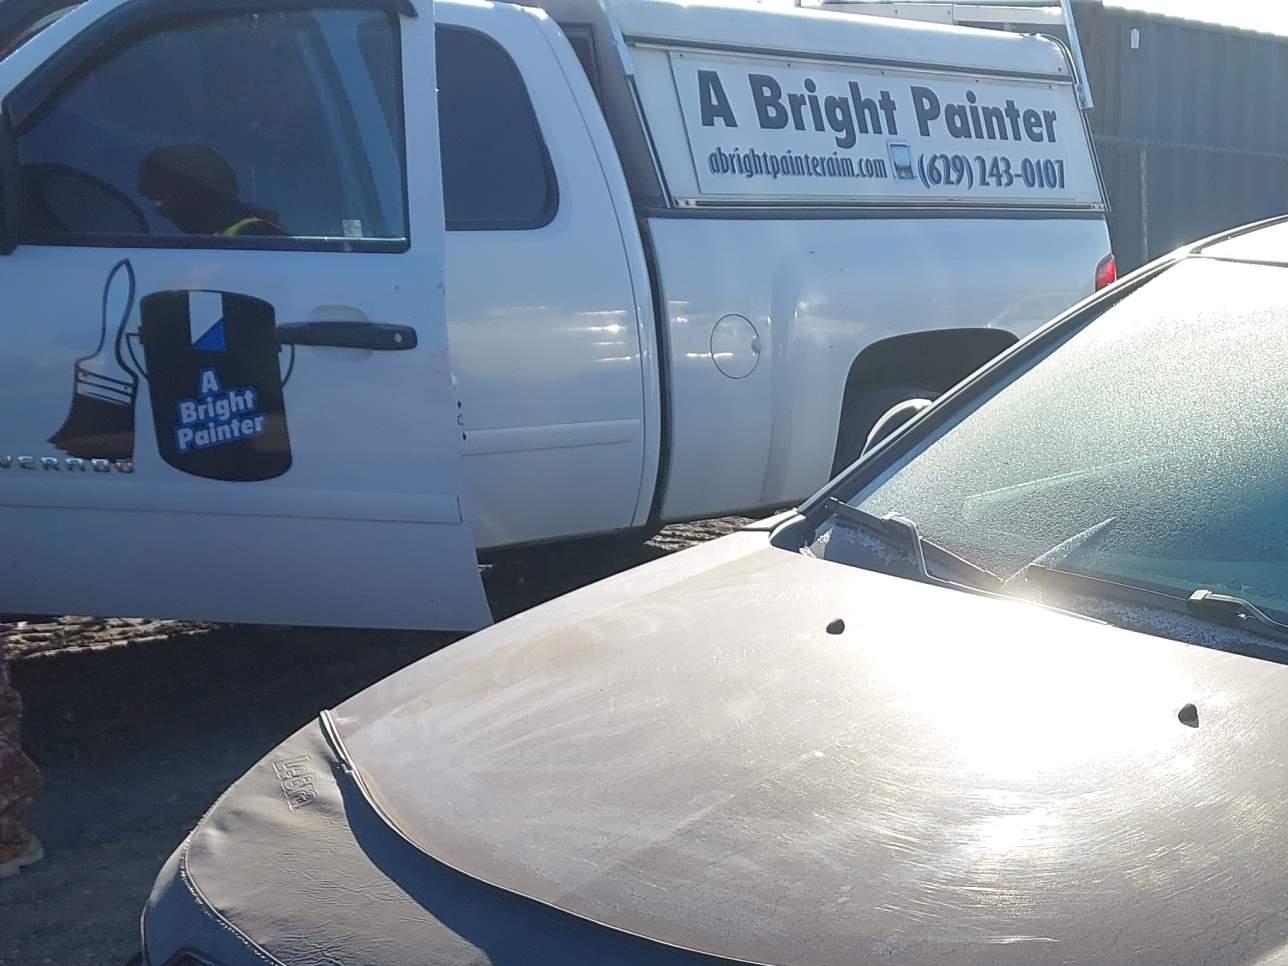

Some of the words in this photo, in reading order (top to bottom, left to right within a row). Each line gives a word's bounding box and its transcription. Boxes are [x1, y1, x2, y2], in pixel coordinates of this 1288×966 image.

[698, 70, 738, 127] A
[748, 73, 898, 148] Bright
[911, 86, 1056, 142] Painter
[708, 146, 887, 179] abrightpainteraim.com
[918, 154, 974, 189] (629)
[974, 156, 1065, 188] 243-0107
[202, 370, 218, 393] A
[180, 390, 254, 423] Bright
[177, 416, 264, 449] Painter
